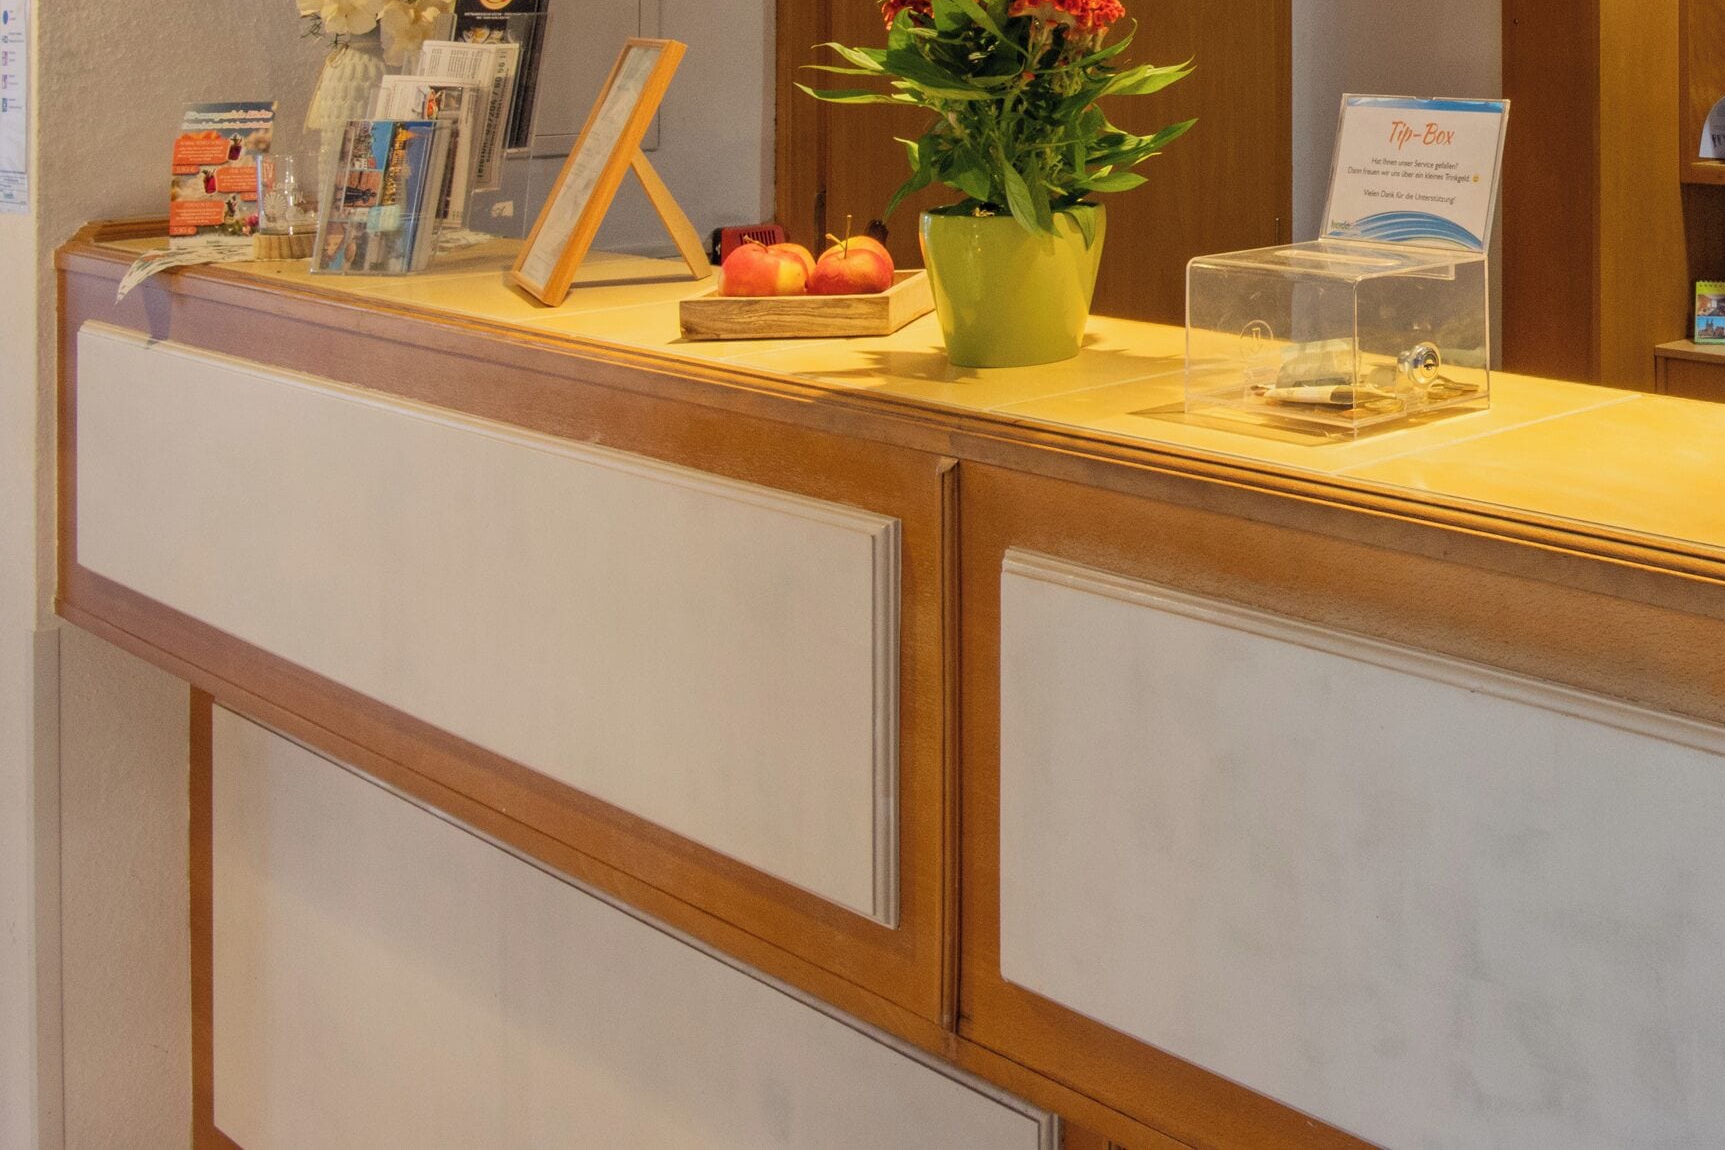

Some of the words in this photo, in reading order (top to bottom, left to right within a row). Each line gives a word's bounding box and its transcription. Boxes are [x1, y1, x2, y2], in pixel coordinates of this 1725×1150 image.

[1388, 120, 1456, 150] Tip-Box
[1382, 158, 1398, 166] Ihnen
[1398, 159, 1414, 167] unser
[1414, 159, 1434, 169] Service
[1434, 161, 1459, 171] gefallen?
[1347, 166, 1362, 174] Dann
[1362, 167, 1380, 176] freuen
[1390, 170, 1400, 178] uns
[1401, 169, 1414, 178] über
[1415, 171, 1424, 179] ein
[1424, 171, 1444, 181] kleines
[1363, 188, 1380, 197] Vielen
[1380, 190, 1395, 199] Dank
[1396, 191, 1404, 200] für
[1404, 192, 1414, 200] die
